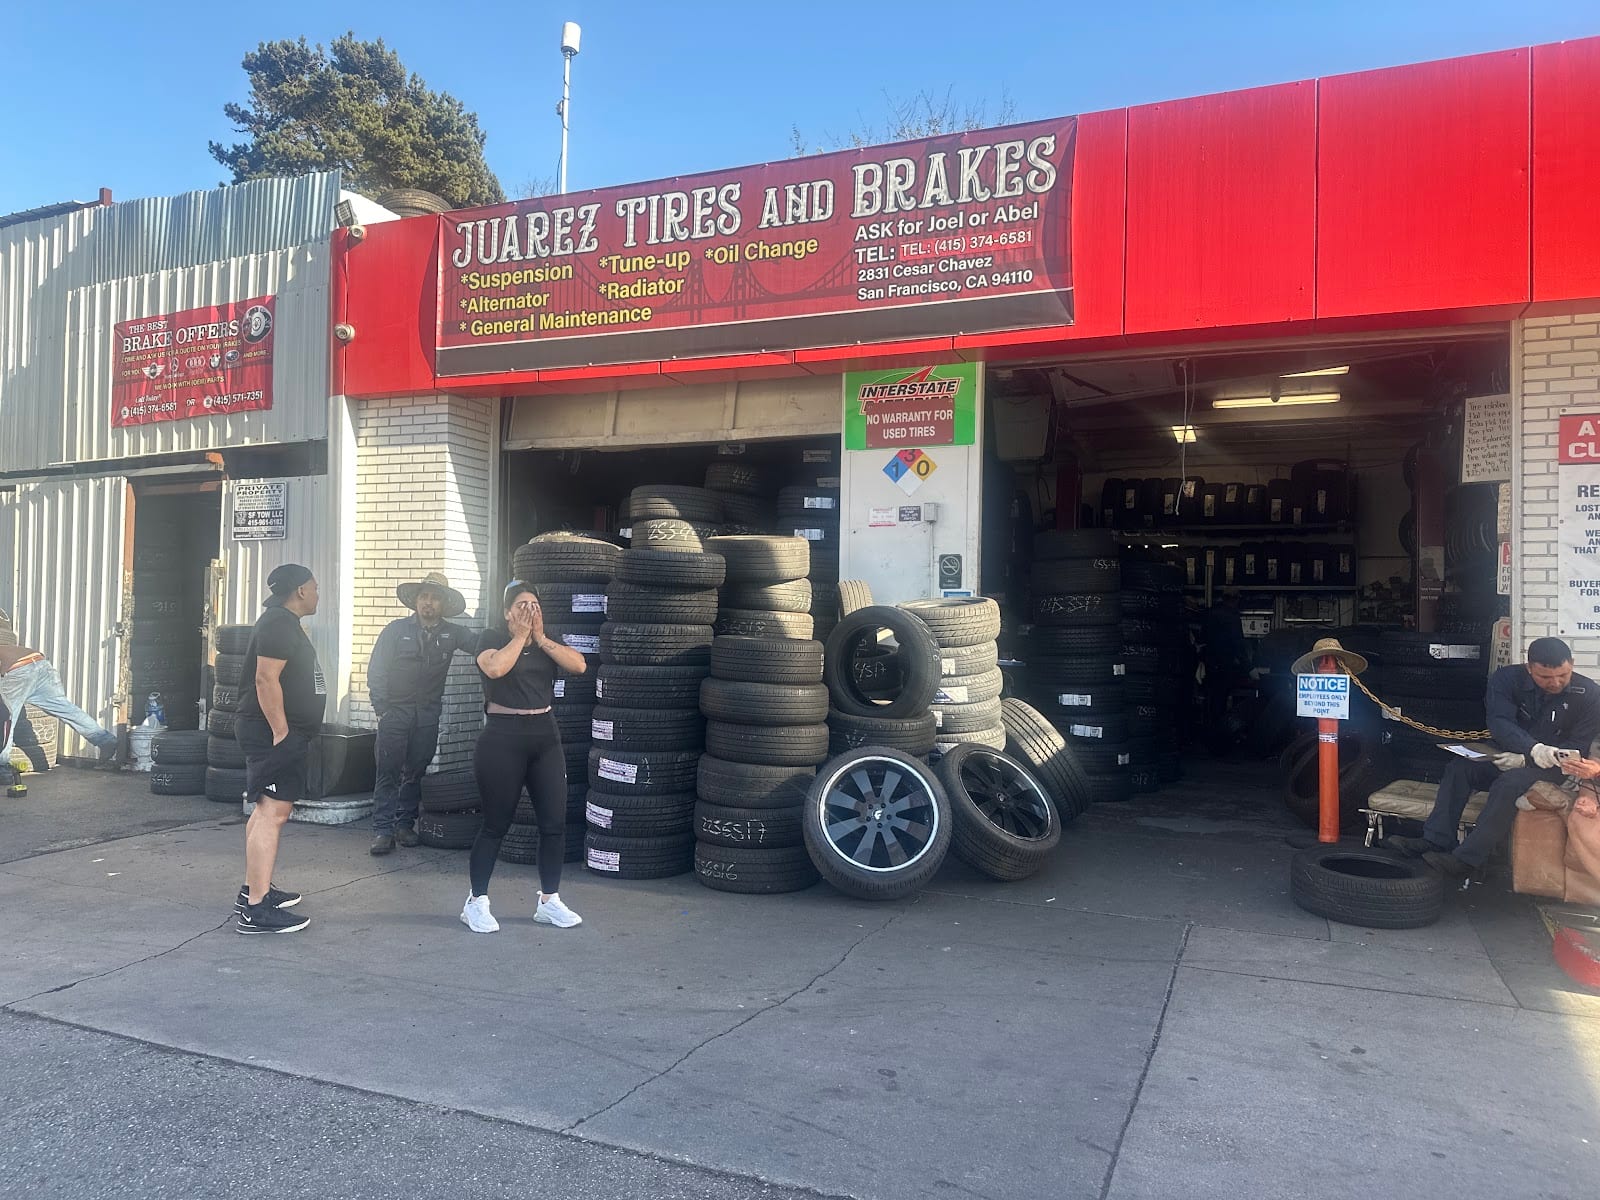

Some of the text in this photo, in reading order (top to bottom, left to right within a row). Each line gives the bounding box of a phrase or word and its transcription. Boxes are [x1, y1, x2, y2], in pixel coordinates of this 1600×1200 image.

[452, 134, 1057, 268] JUAREZ TIRES AND BRAKES
[854, 202, 1039, 242] ASK for Joel or Abel
[745, 236, 819, 262] Change
[901, 230, 1033, 257] TEL: (415) 374-6581
[854, 247, 896, 264] TEL:
[857, 256, 993, 282] 2831 Cesar Chavez
[857, 269, 1033, 301] San Francisco, CA 94110
[129, 320, 168, 334] THE BEST
[470, 313, 535, 337] General
[538, 305, 653, 332] Maintenance
[122, 319, 239, 353] BRAKE OFFERS
[861, 380, 957, 398] INTERSTATE
[213, 390, 263, 406] (415) 571-7351
[866, 409, 953, 425] NO WARRANTY FOR
[882, 426, 936, 439] USED TIRES
[1577, 420, 1600, 437] A
[903, 449, 916, 462] 3
[891, 461, 900, 478] 1
[256, 511, 271, 519] TOW
[271, 510, 284, 518] LLC
[1573, 546, 1599, 554] THAT
[1580, 588, 1600, 596] FOR
[1299, 677, 1346, 691] NOTICE
